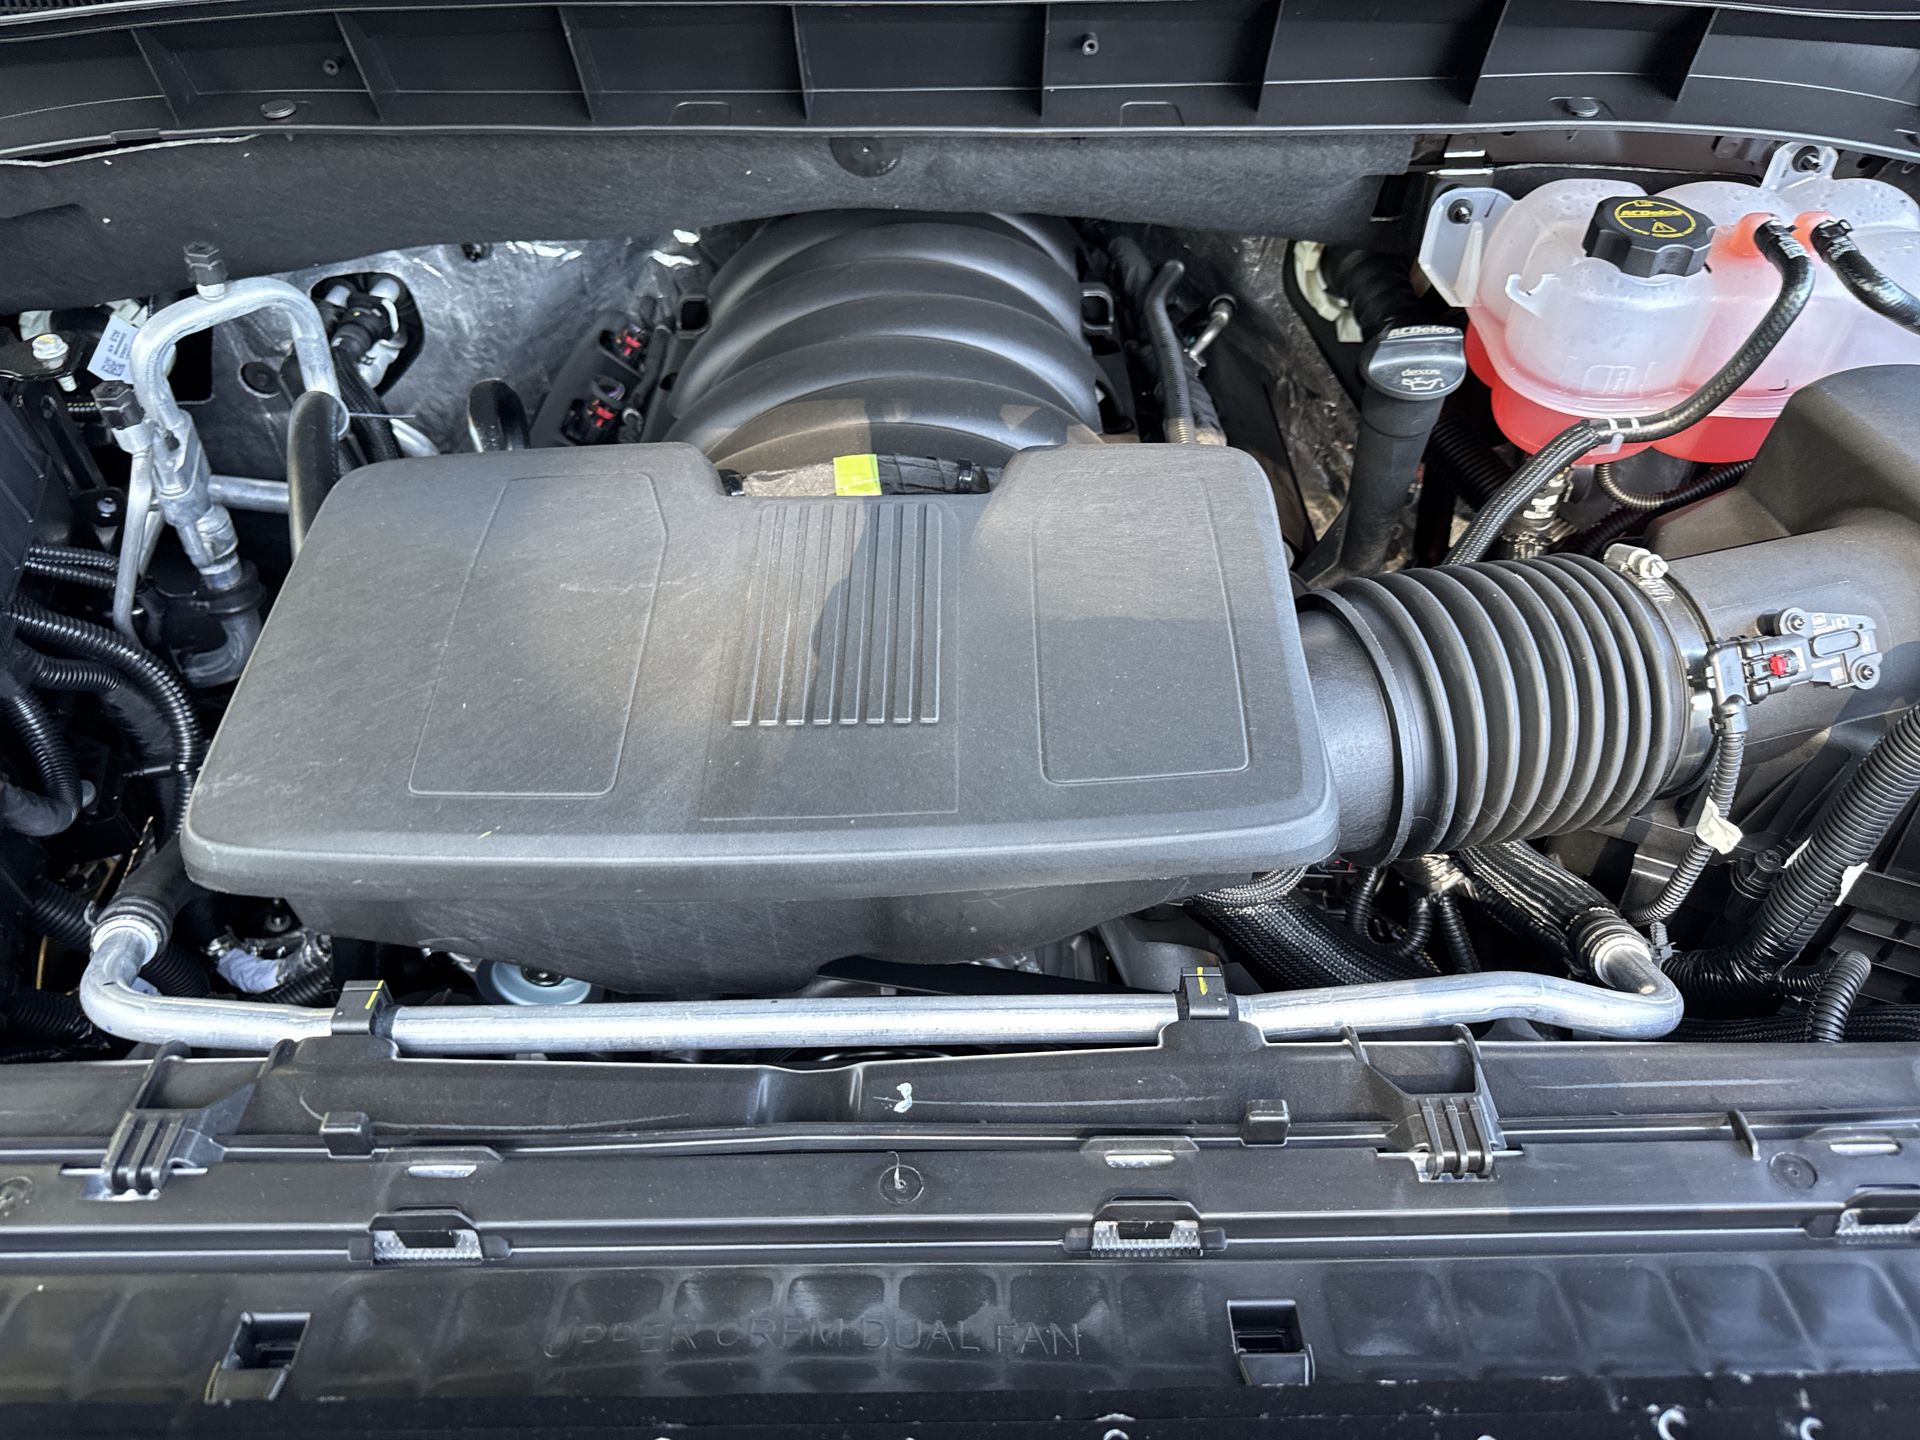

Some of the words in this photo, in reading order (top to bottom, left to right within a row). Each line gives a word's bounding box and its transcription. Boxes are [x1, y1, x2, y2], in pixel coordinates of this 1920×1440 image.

[1387, 325, 1457, 339] ACDelco
[1401, 368, 1441, 377] dexos
[863, 1318, 980, 1352] DUAL
[994, 1321, 1080, 1356] FAN
